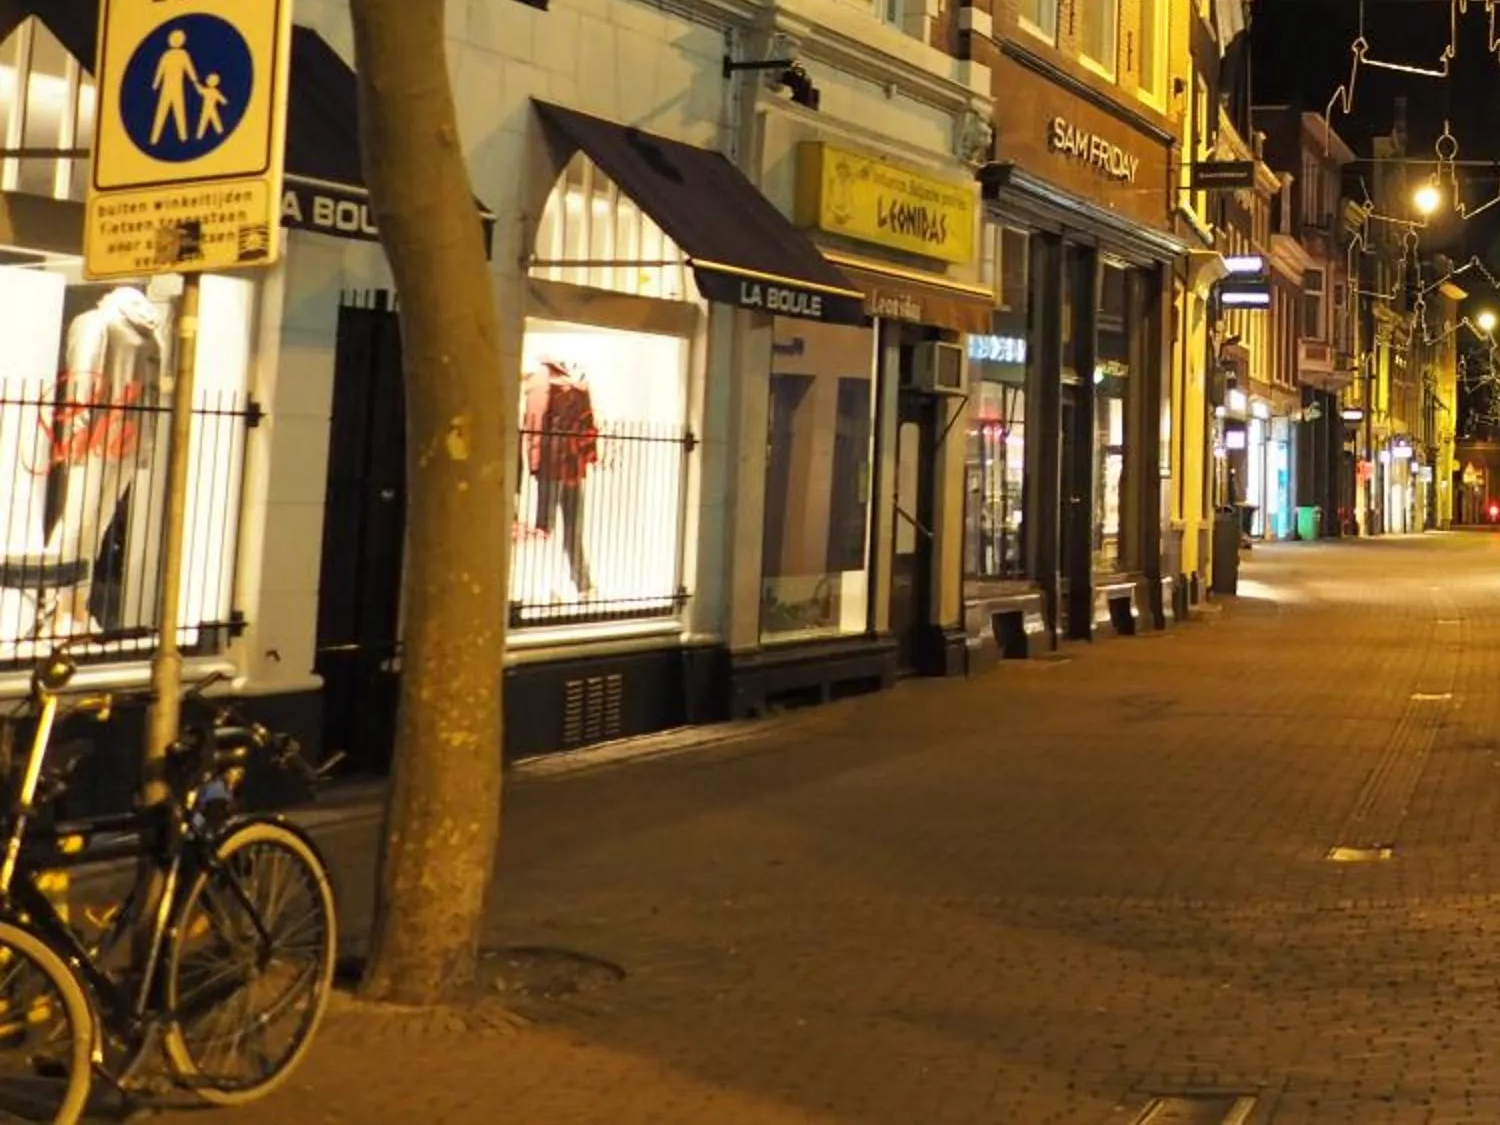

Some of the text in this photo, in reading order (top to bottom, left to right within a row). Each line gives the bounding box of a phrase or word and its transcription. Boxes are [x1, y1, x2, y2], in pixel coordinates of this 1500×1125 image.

[1053, 116, 1139, 183] SAM FRIDAY
[97, 189, 254, 218] buiten winkeltijden
[877, 194, 947, 245] LEONIDAS
[99, 219, 153, 236] fietsen
[740, 282, 822, 317] LA BOULE
